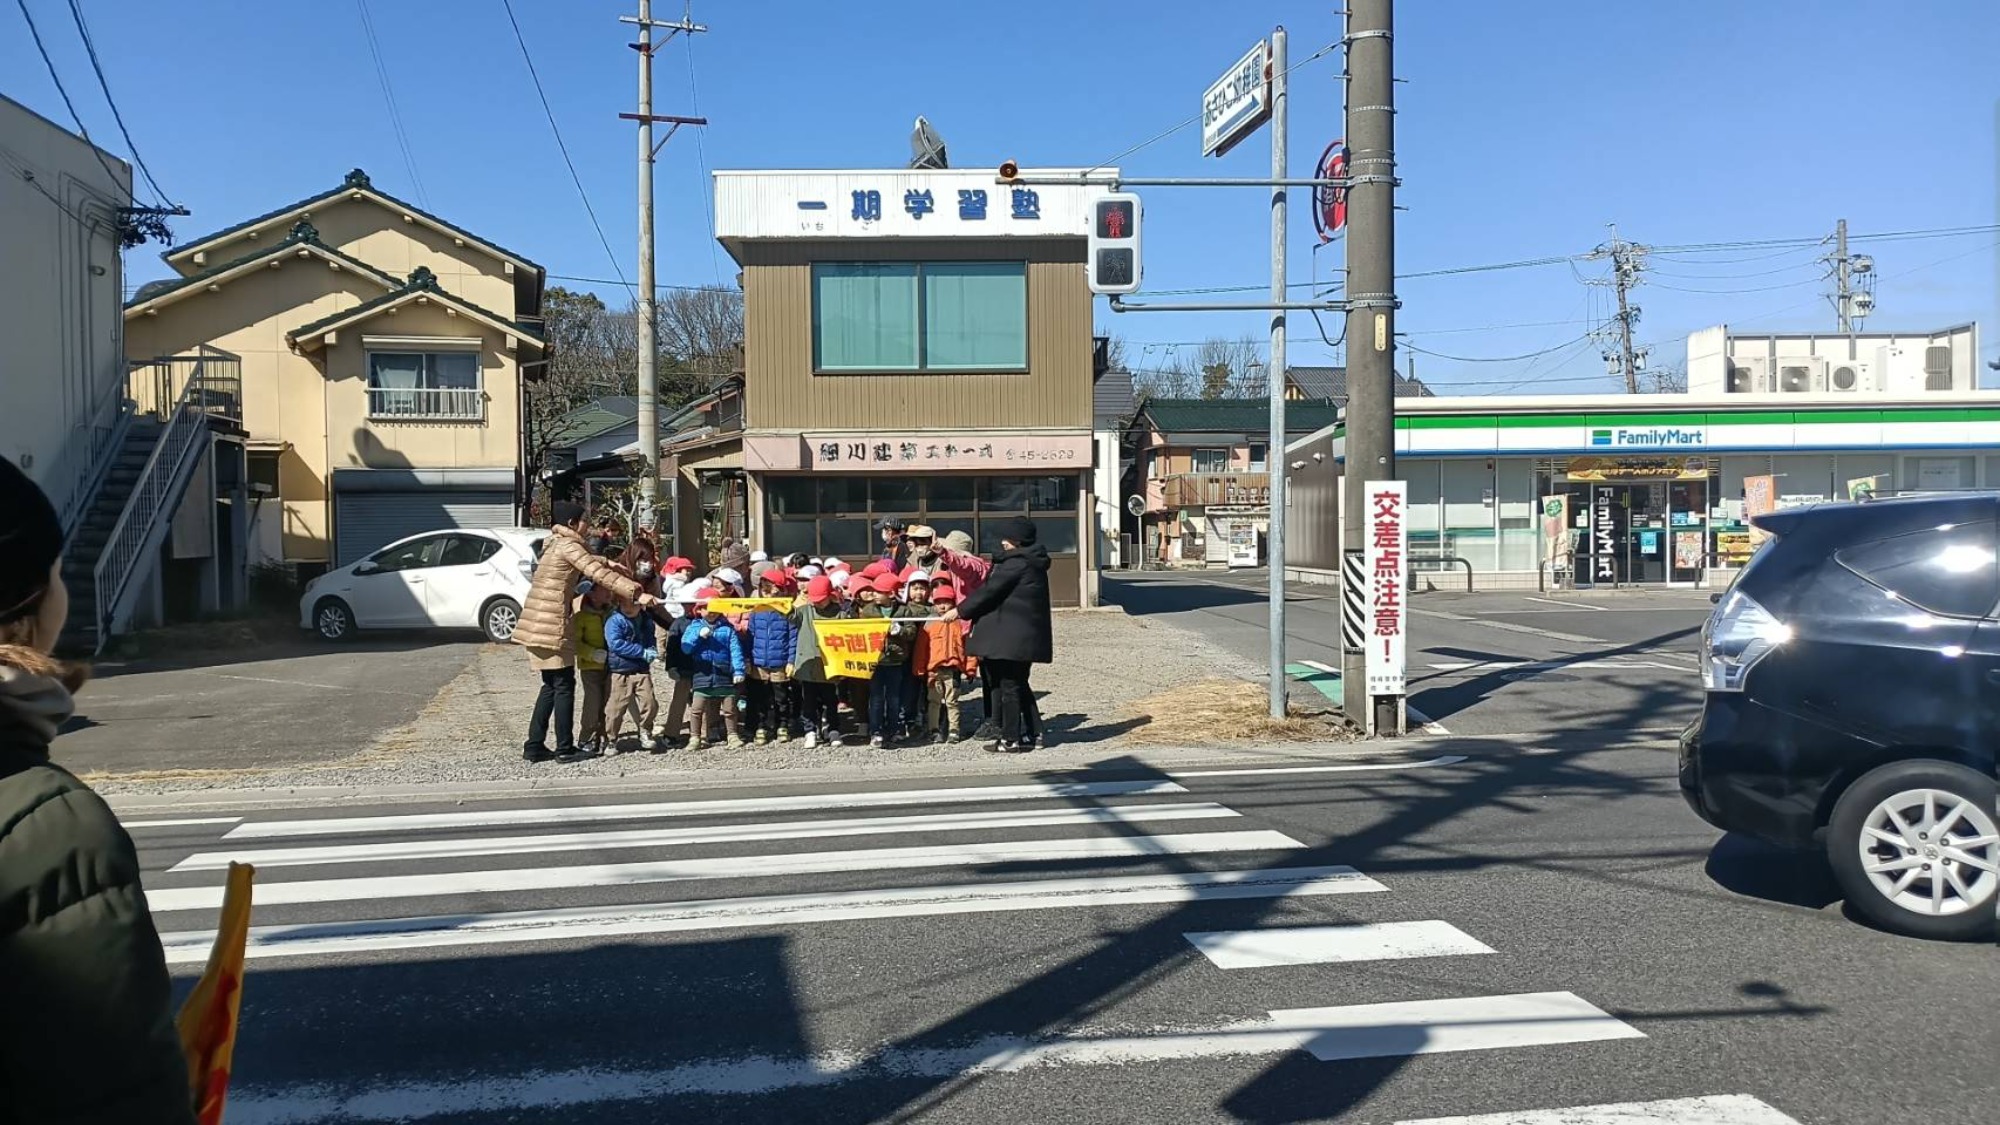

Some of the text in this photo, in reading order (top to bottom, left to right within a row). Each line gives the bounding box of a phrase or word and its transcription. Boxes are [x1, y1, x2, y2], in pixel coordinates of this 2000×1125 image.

[797, 188, 1041, 221] 一期学習塾
[1618, 430, 1702, 445] FamilyMart
[1596, 487, 1614, 577] FamilyMart
[1373, 491, 1400, 663] 交差点注意！
